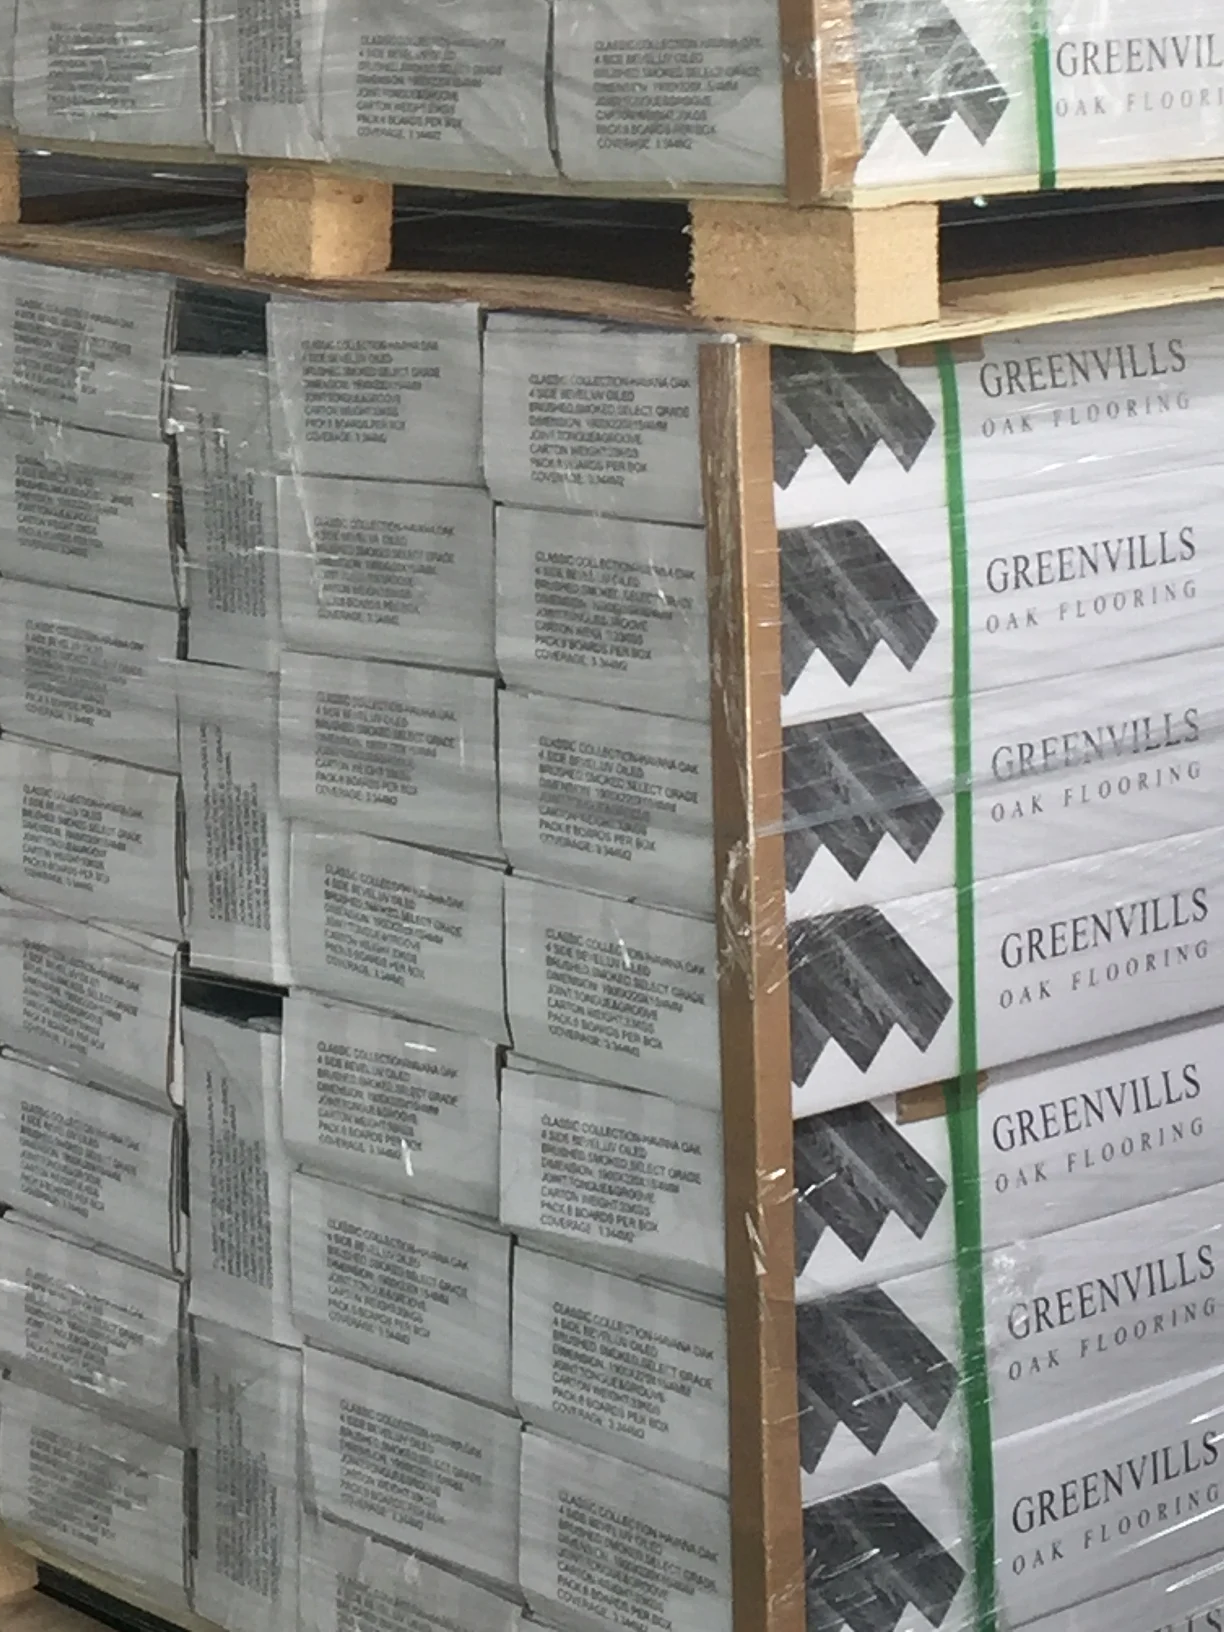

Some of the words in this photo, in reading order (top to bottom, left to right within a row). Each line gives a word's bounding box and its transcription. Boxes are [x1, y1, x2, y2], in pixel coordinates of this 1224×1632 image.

[1056, 33, 1224, 77] GREENVIL
[1056, 95, 1107, 117] OAK
[1127, 86, 1224, 112] FLOORI
[980, 338, 1187, 398] GREENVILLS
[982, 415, 1033, 438] OAK
[1053, 391, 1190, 428] FLOORING
[986, 526, 1197, 594] GREENVILLS
[986, 607, 1039, 634] OAK
[1059, 579, 1197, 621] FLOORING
[991, 708, 1201, 783] GREENVILLS
[991, 793, 1044, 822] OAK
[1063, 760, 1202, 807] FLOORING
[1000, 887, 1209, 970] GREENVILLS
[999, 979, 1053, 1010] OAK
[1071, 939, 1209, 991] FLOORING
[992, 1063, 1201, 1152] GREENVILLS
[995, 1161, 1048, 1194] OAK
[1067, 1117, 1204, 1172] FLOORING
[1007, 1244, 1216, 1340] GREENVILLS
[1009, 1349, 1061, 1381] OAK
[1079, 1296, 1217, 1358] FLOORING
[1012, 1430, 1219, 1534] GREENVILLS
[1012, 1540, 1064, 1576] OAK
[1083, 1483, 1220, 1549] FLOORING
